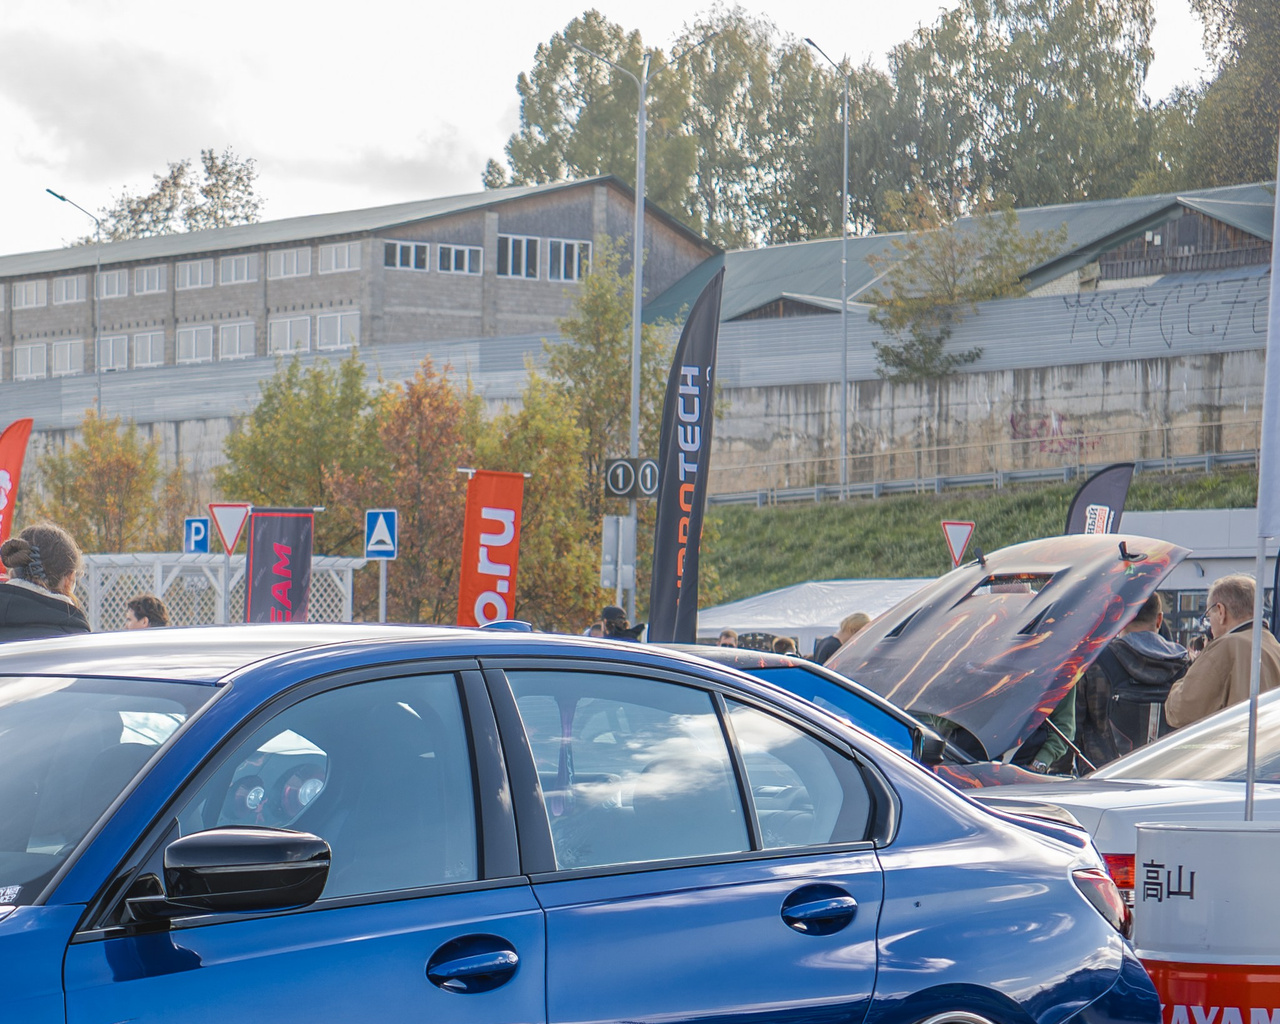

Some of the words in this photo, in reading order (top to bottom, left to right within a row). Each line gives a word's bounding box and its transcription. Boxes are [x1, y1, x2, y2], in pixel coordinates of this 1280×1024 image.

[616, 466, 624, 489] 1
[645, 466, 652, 489] 1
[1142, 859, 1196, 903] 高山
